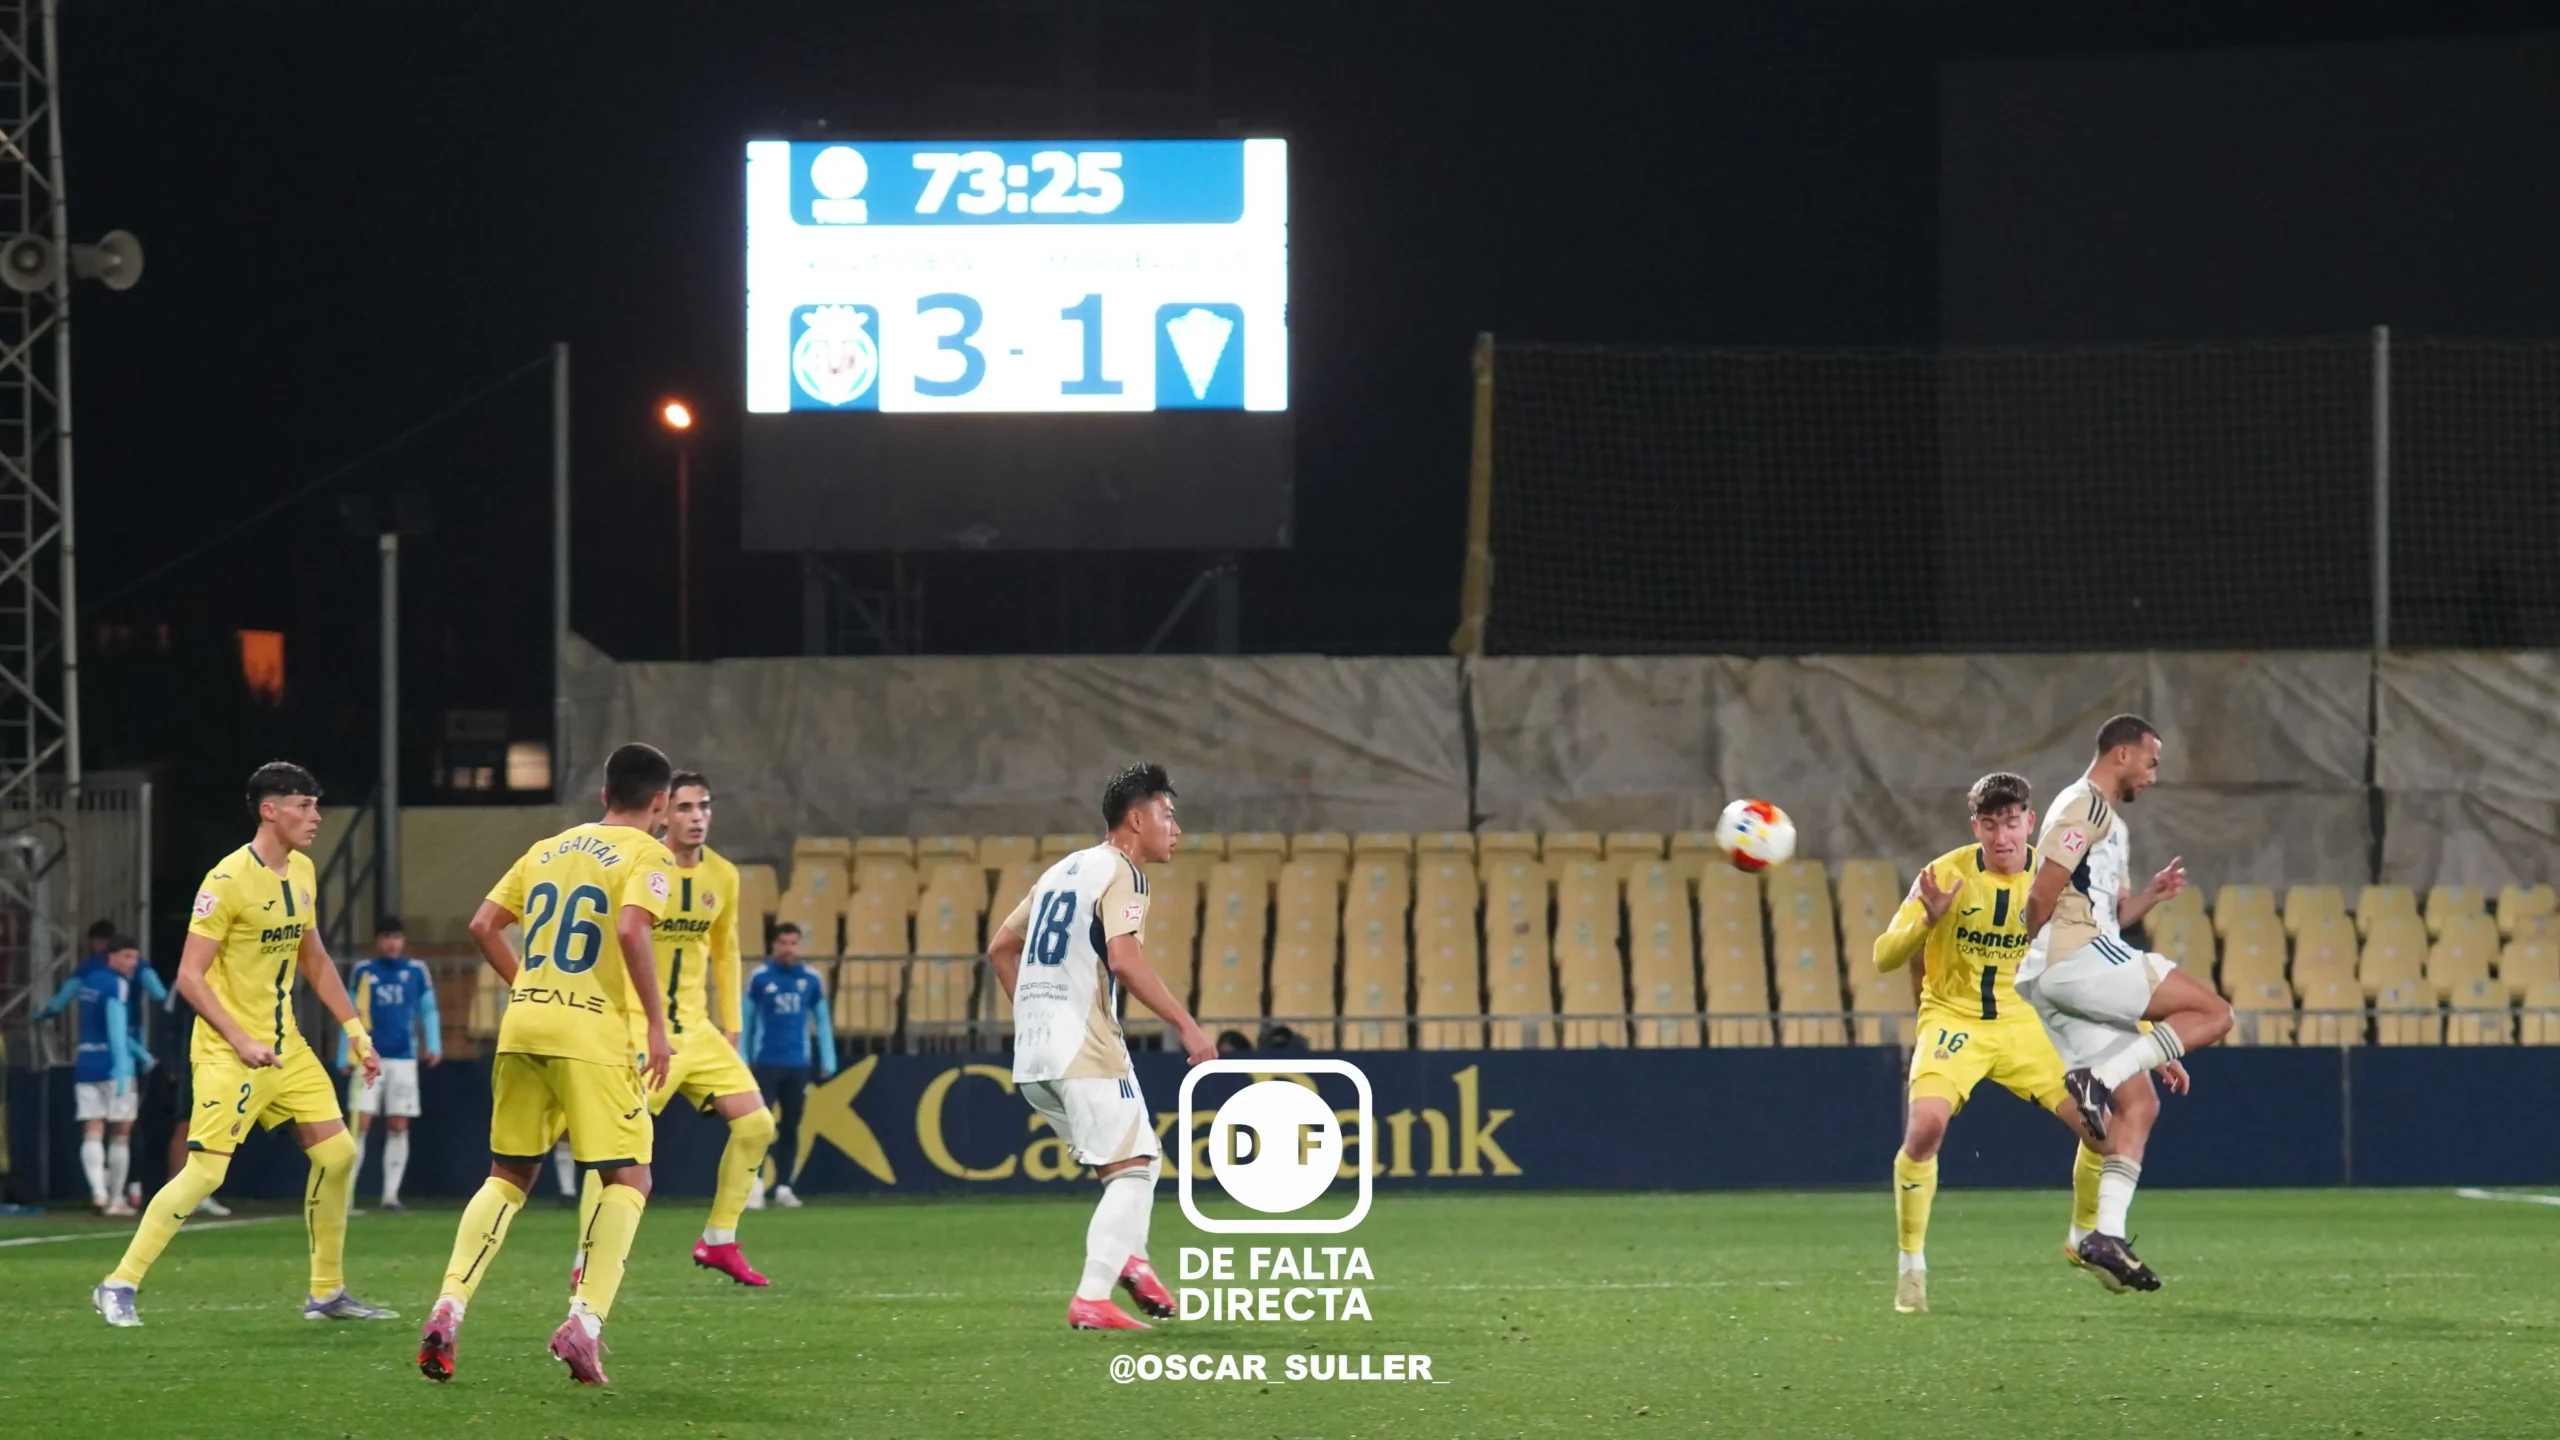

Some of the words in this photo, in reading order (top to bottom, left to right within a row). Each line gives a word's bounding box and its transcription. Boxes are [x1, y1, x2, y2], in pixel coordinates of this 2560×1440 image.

[913, 151, 1123, 215] 73:25
[913, 292, 987, 397] 3
[1060, 293, 1124, 396] 1
[540, 851, 557, 865] J.
[559, 835, 622, 868] GAITÁN
[525, 881, 609, 974] 26
[1027, 889, 1077, 967] 18
[1938, 1028, 1969, 1053] 16
[237, 1083, 251, 1114] 2
